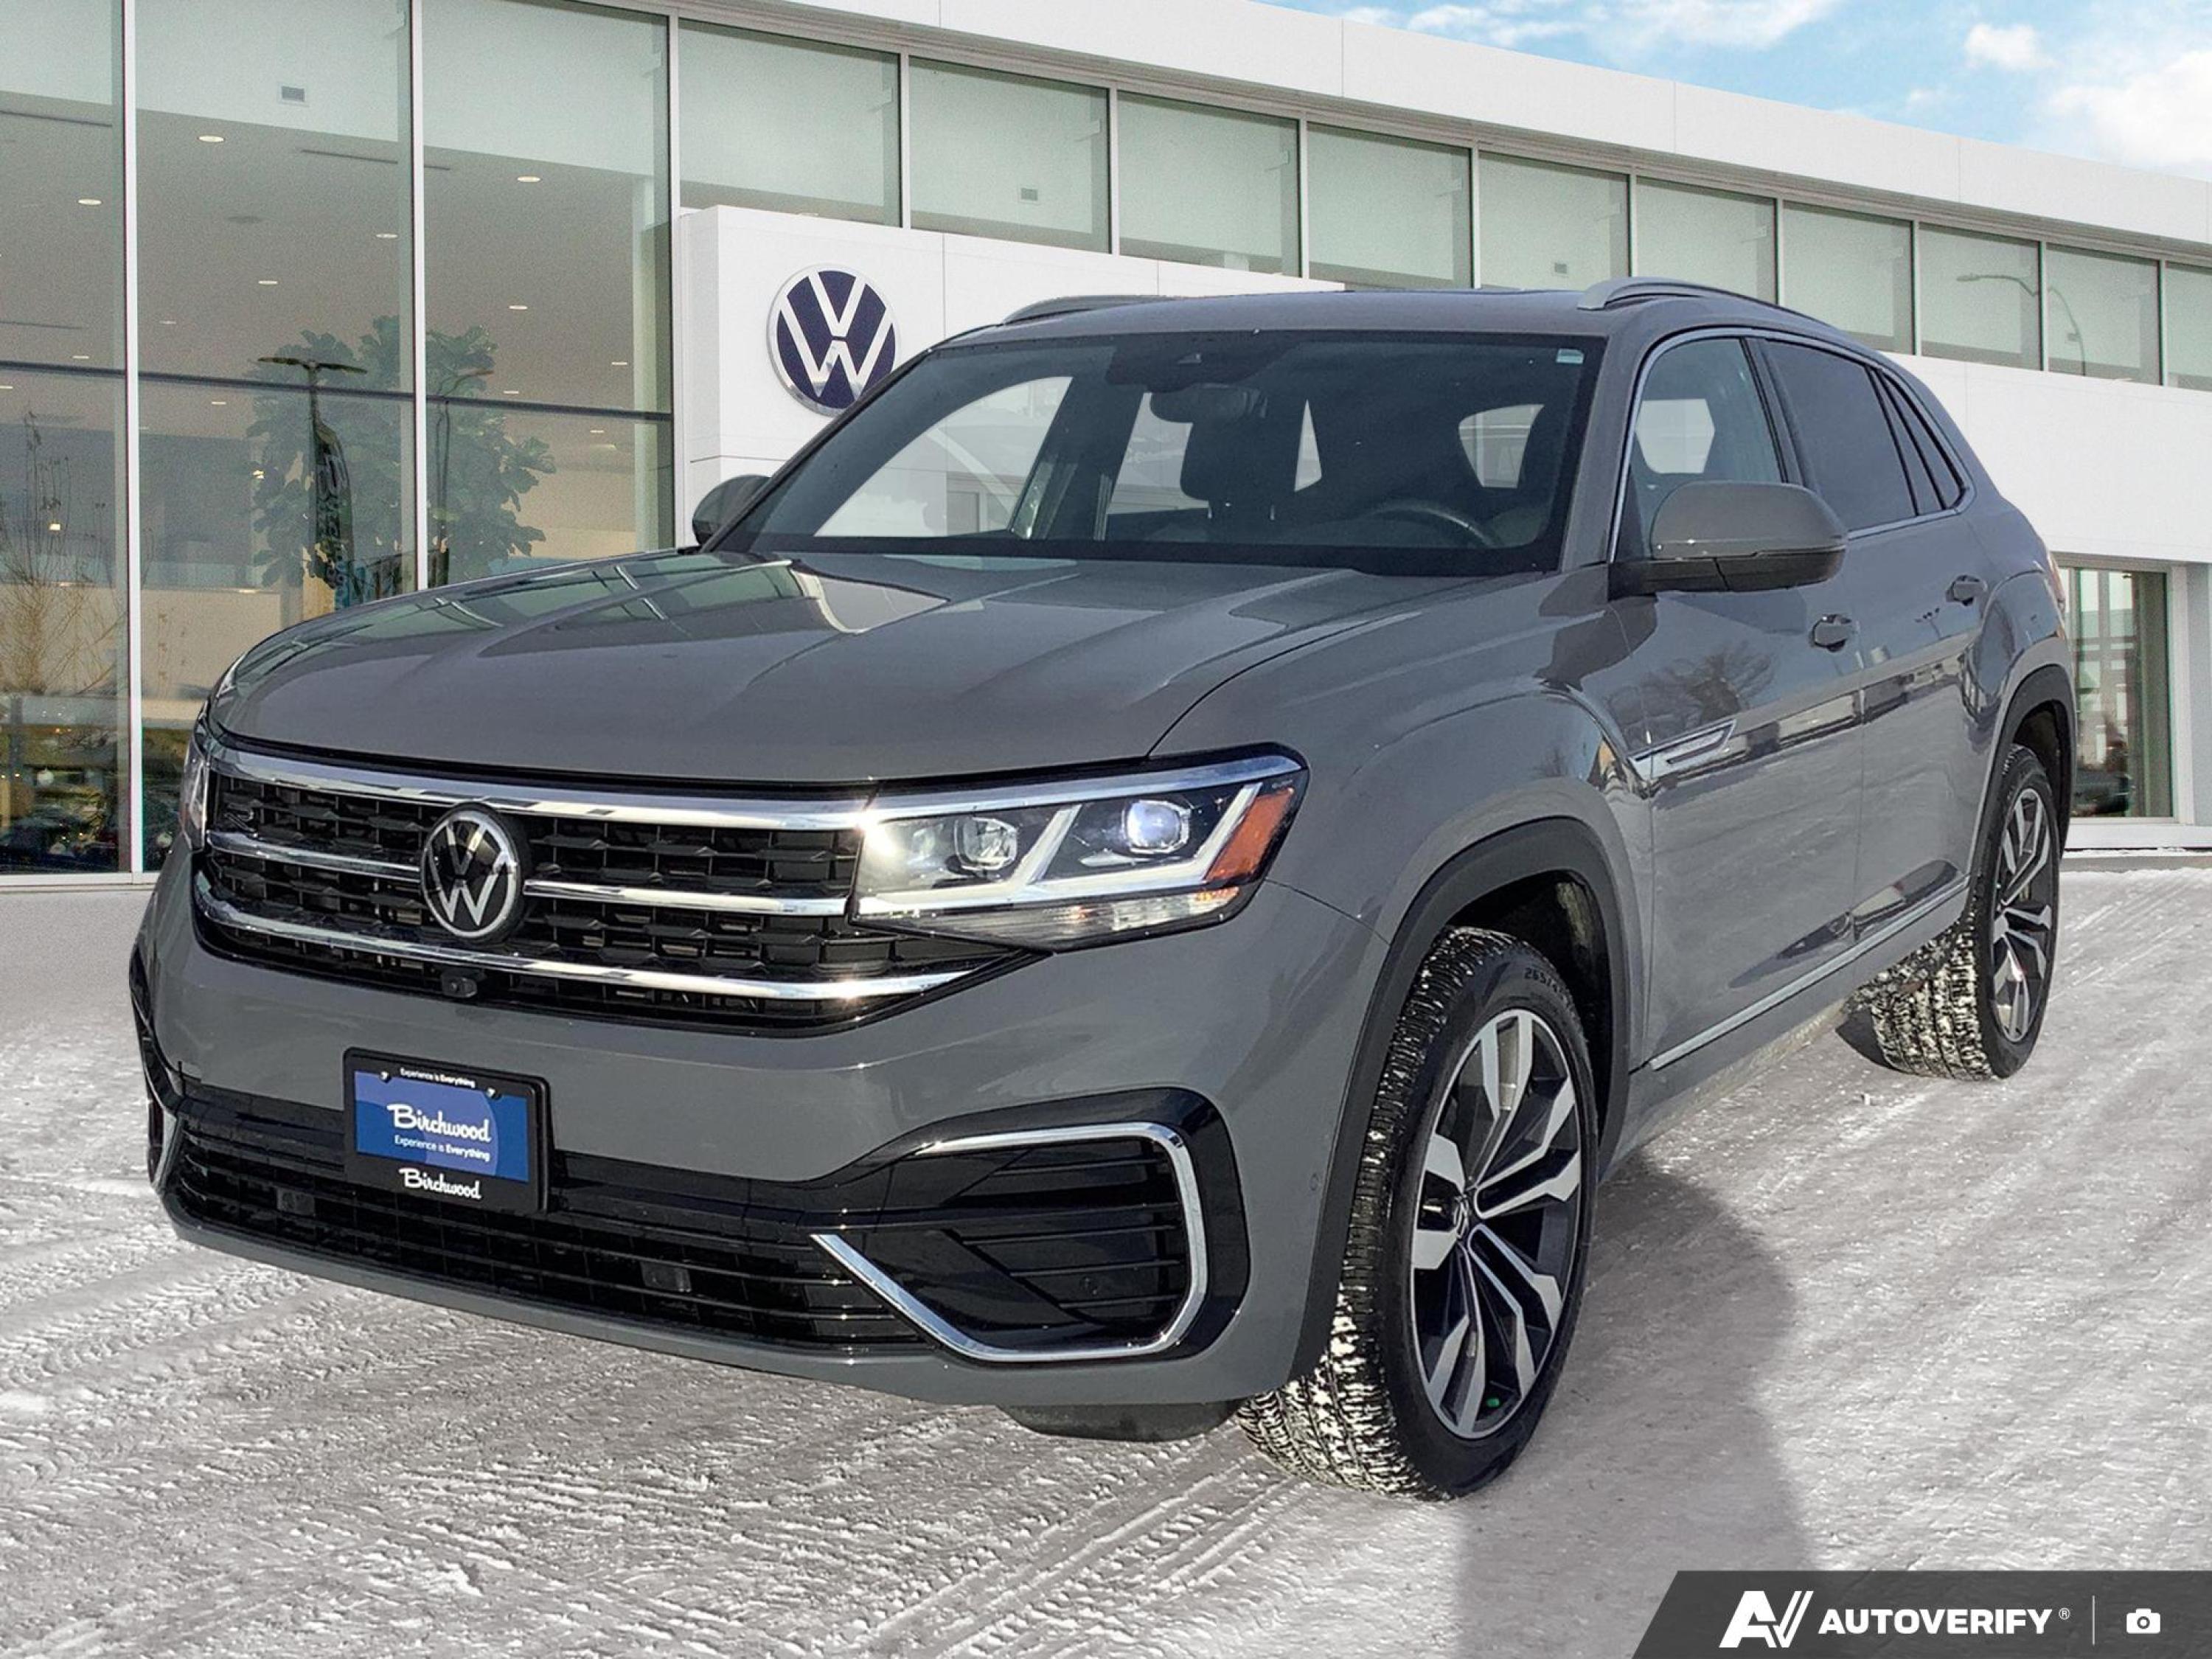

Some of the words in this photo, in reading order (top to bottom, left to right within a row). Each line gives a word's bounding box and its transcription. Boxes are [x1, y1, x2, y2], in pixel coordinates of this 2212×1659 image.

[387, 1104, 492, 1142] Birchwood
[394, 1134, 437, 1152] Experience
[445, 1144, 490, 1162] Everything
[398, 1168, 481, 1200] Birchwood
